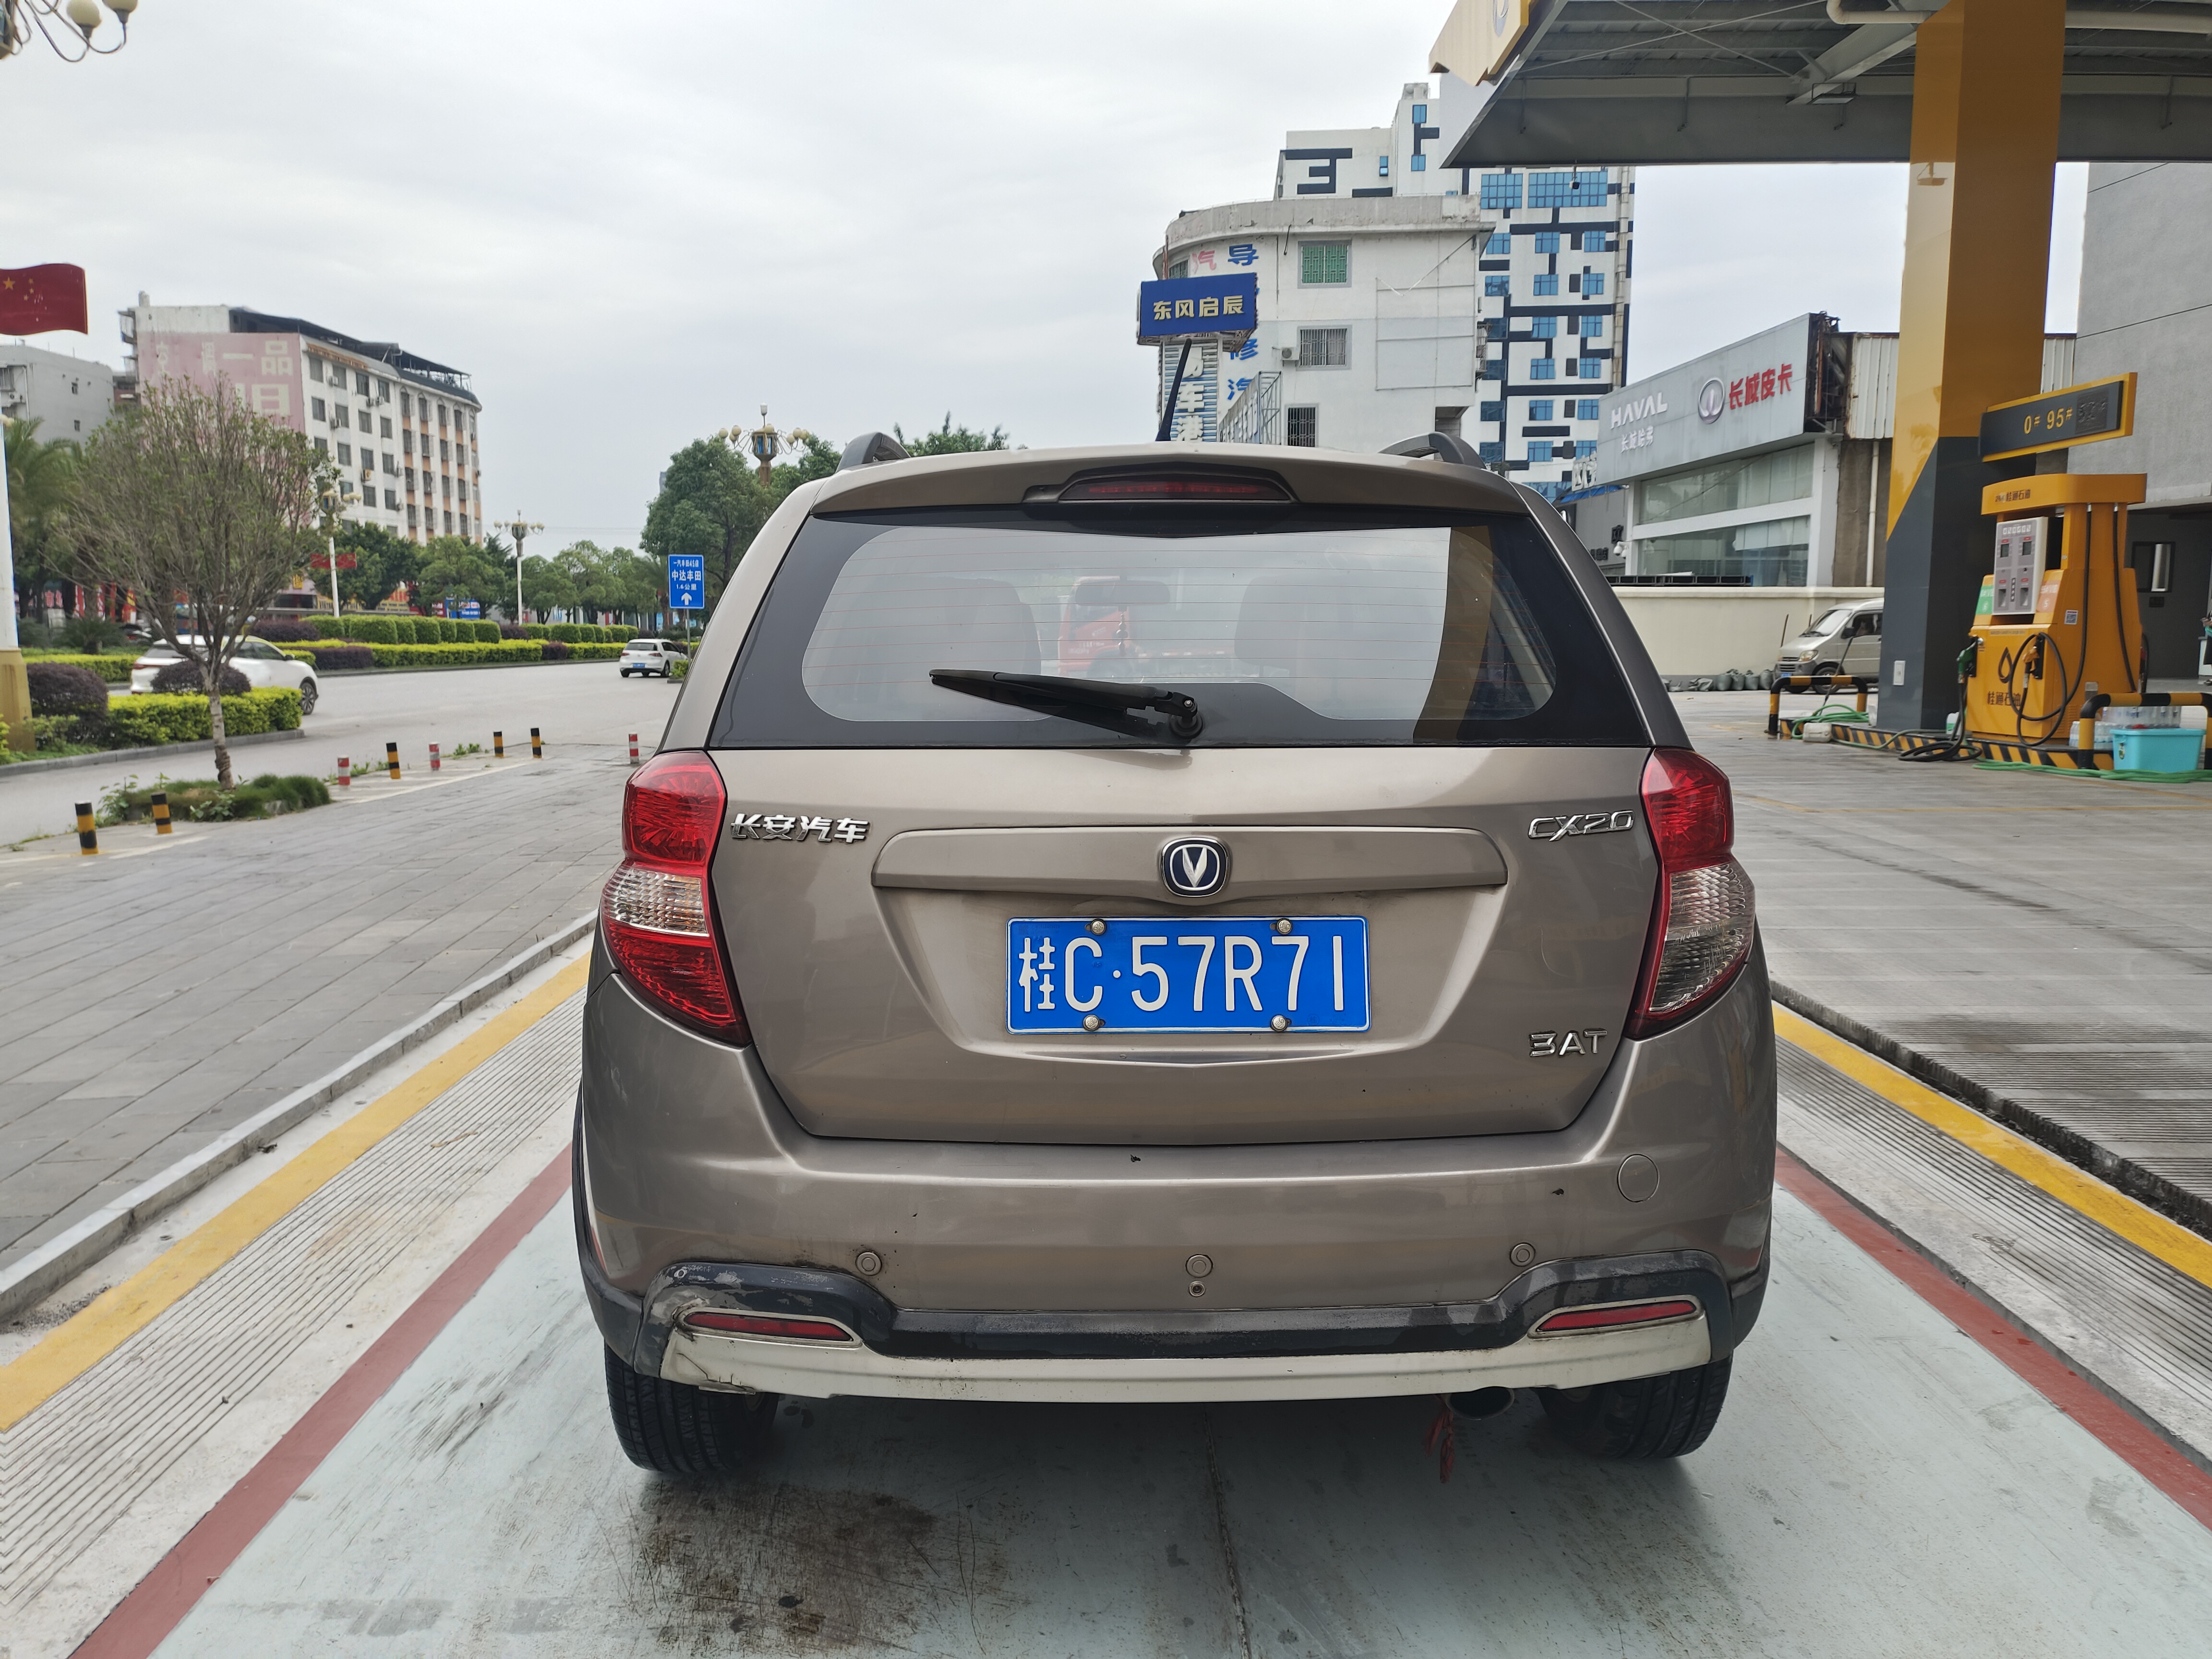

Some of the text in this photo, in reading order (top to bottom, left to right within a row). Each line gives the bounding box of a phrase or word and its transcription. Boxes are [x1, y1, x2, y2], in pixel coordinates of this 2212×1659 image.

[1153, 294, 1244, 321] 东风启辰
[1729, 363, 1792, 410] 长城皮卡
[1611, 392, 1668, 430] HAVAL
[2024, 414, 2040, 434] 0#
[2046, 407, 2073, 430] 95#
[1621, 425, 1654, 454] 长城哈弗
[672, 569, 701, 581] 中达丰田
[1987, 691, 2021, 707] 桂通石油
[730, 813, 870, 843] 长安汽车
[1528, 809, 1635, 842] CX20
[1529, 1030, 1608, 1057] 3AT
